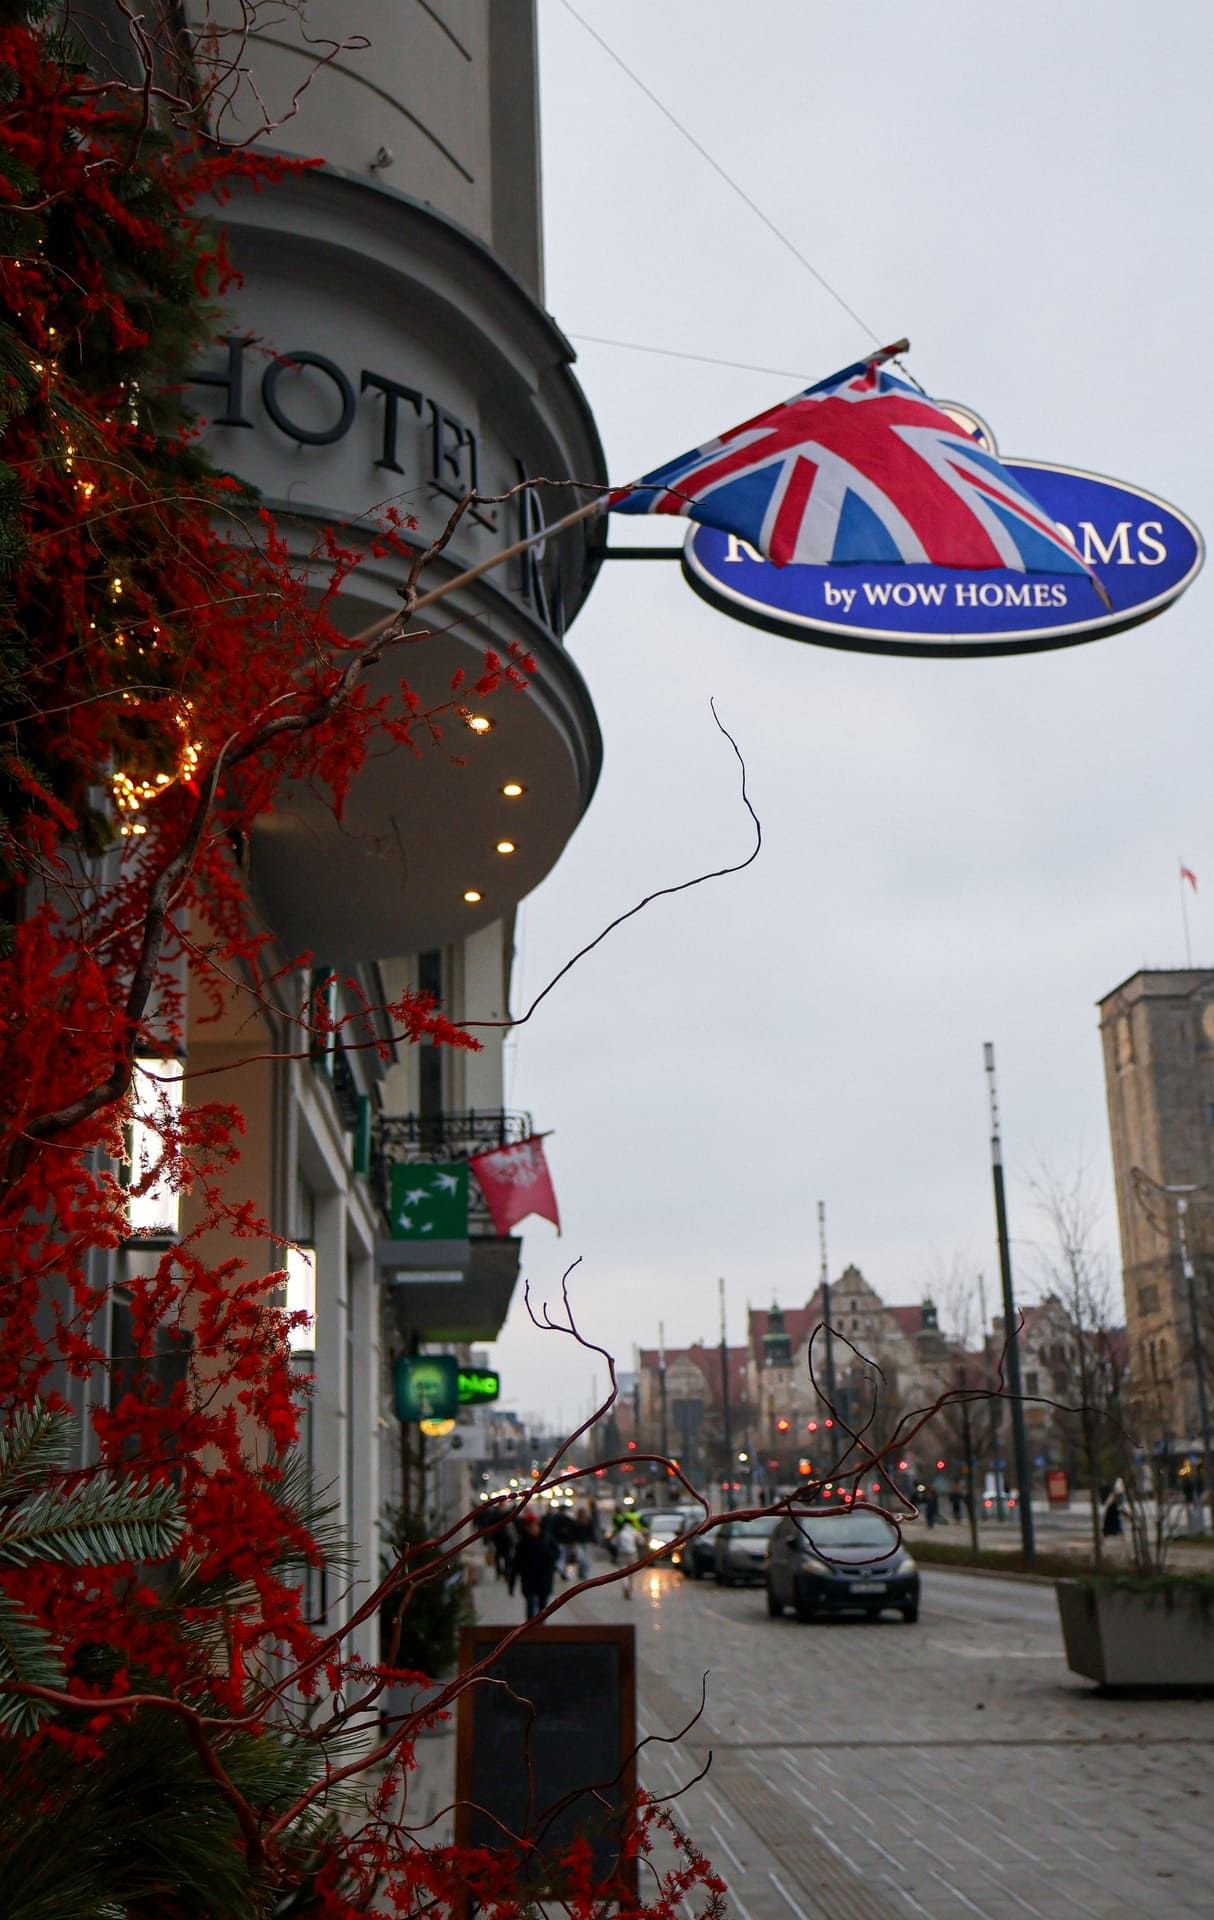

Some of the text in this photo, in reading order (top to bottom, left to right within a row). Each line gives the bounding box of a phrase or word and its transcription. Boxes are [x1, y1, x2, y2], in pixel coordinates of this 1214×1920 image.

[184, 334, 497, 534] HOTEL
[823, 581, 1068, 613] by WOW HOMES
